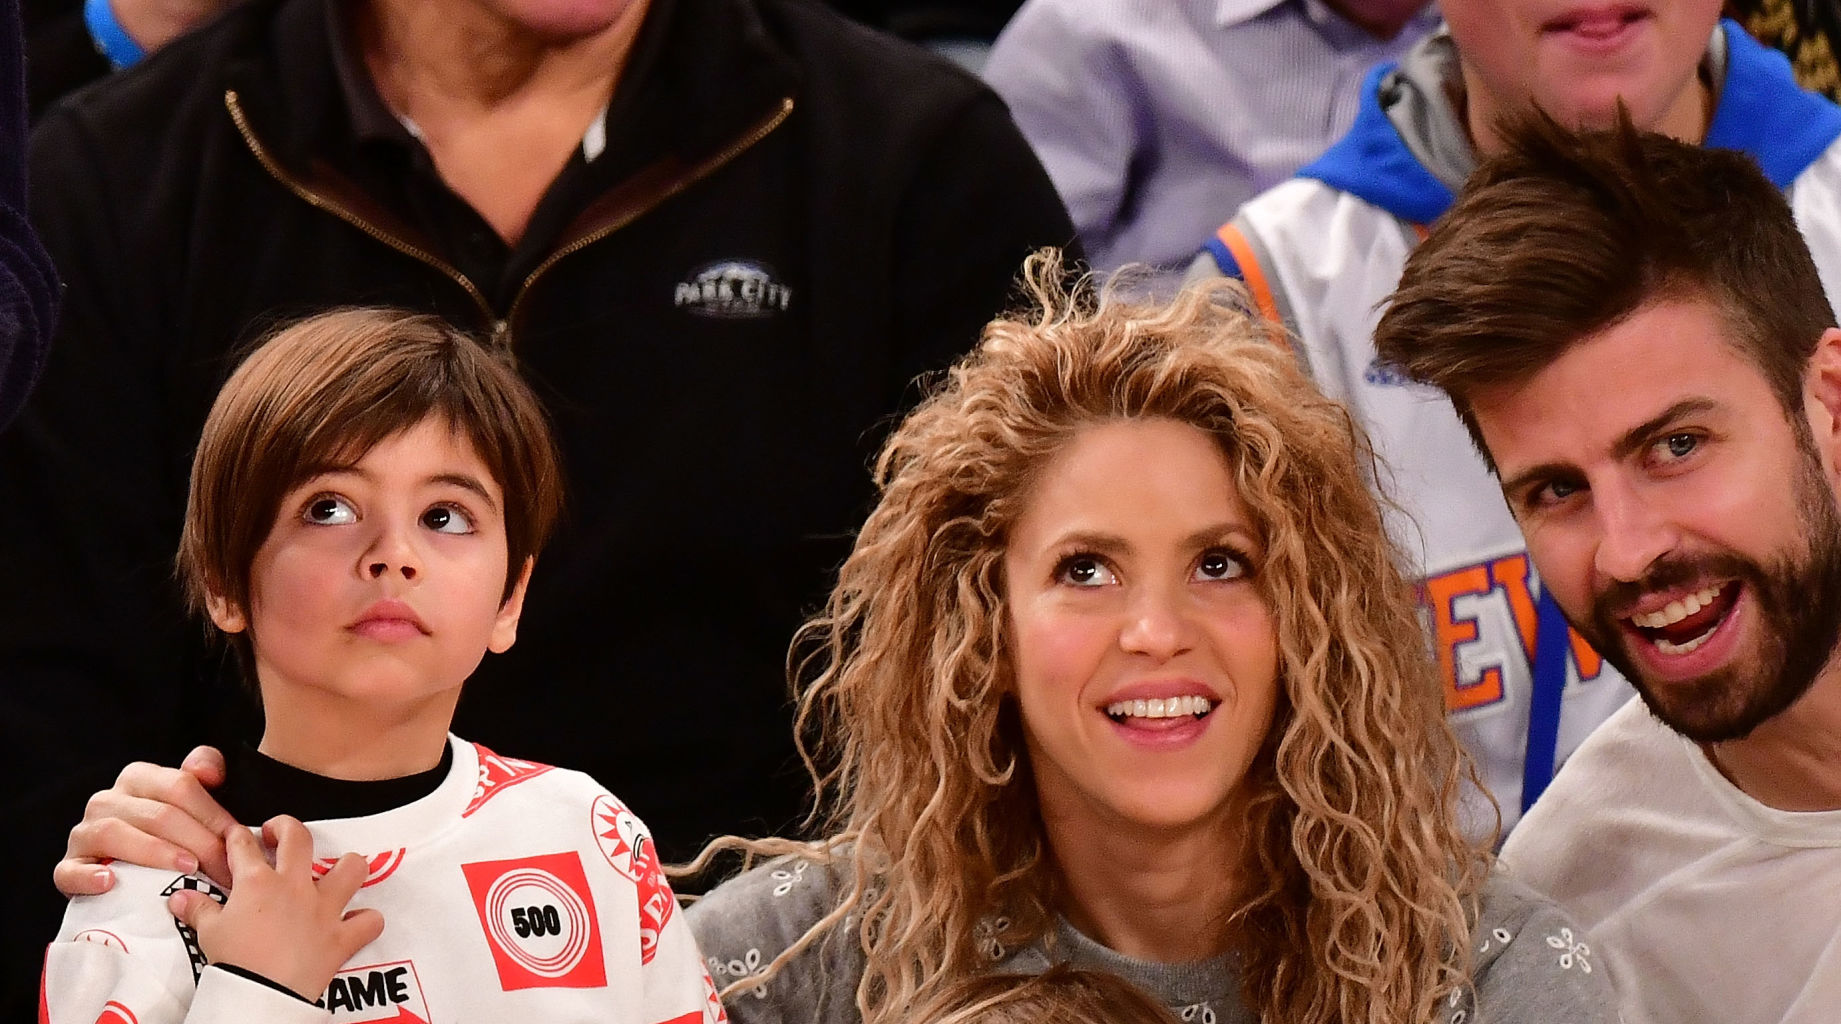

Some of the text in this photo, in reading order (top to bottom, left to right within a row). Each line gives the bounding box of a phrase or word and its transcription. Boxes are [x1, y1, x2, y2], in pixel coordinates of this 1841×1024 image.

[741, 281, 792, 311] CITY
[511, 904, 561, 939] 500
[317, 966, 410, 1015] AME
